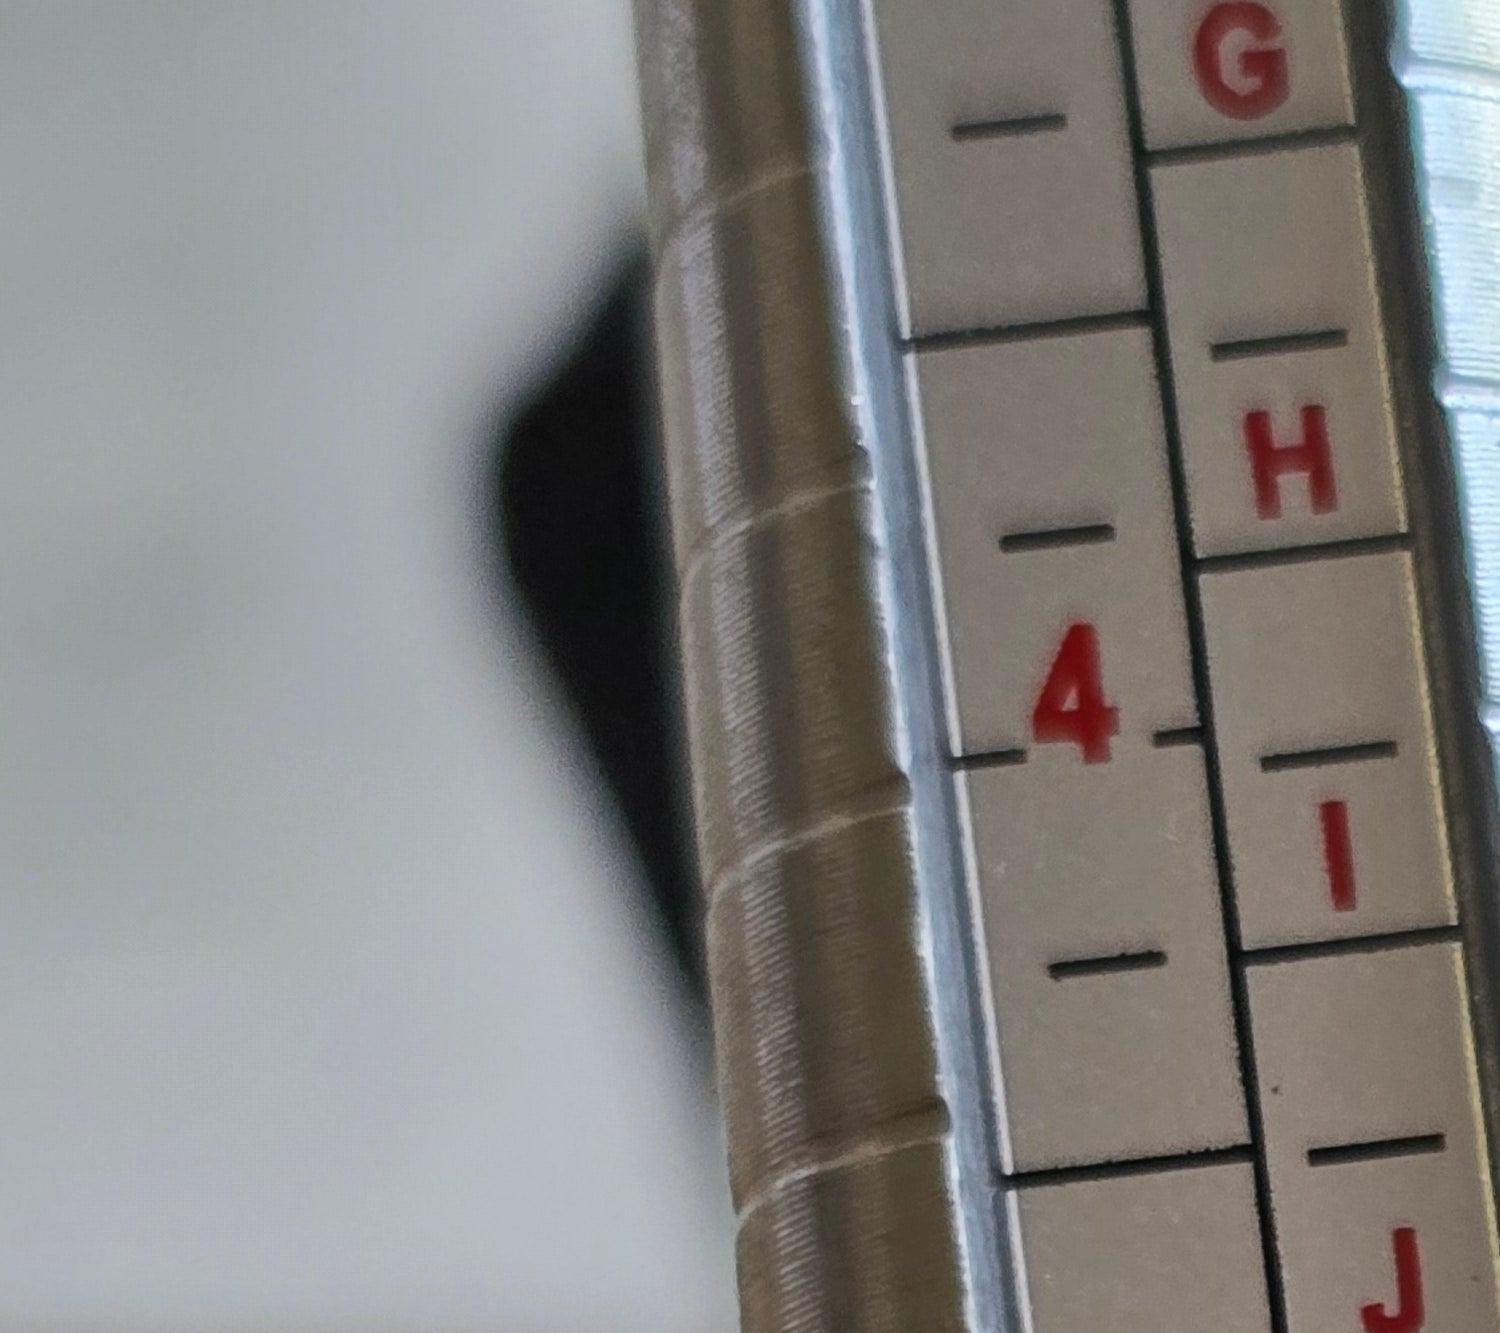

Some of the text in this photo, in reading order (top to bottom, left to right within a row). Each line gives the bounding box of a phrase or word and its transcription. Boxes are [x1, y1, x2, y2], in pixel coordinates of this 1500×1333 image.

[1194, 1, 1289, 120] G
[1243, 405, 1336, 518] H
[1031, 619, 1117, 763] 4
[1319, 800, 1357, 913] I
